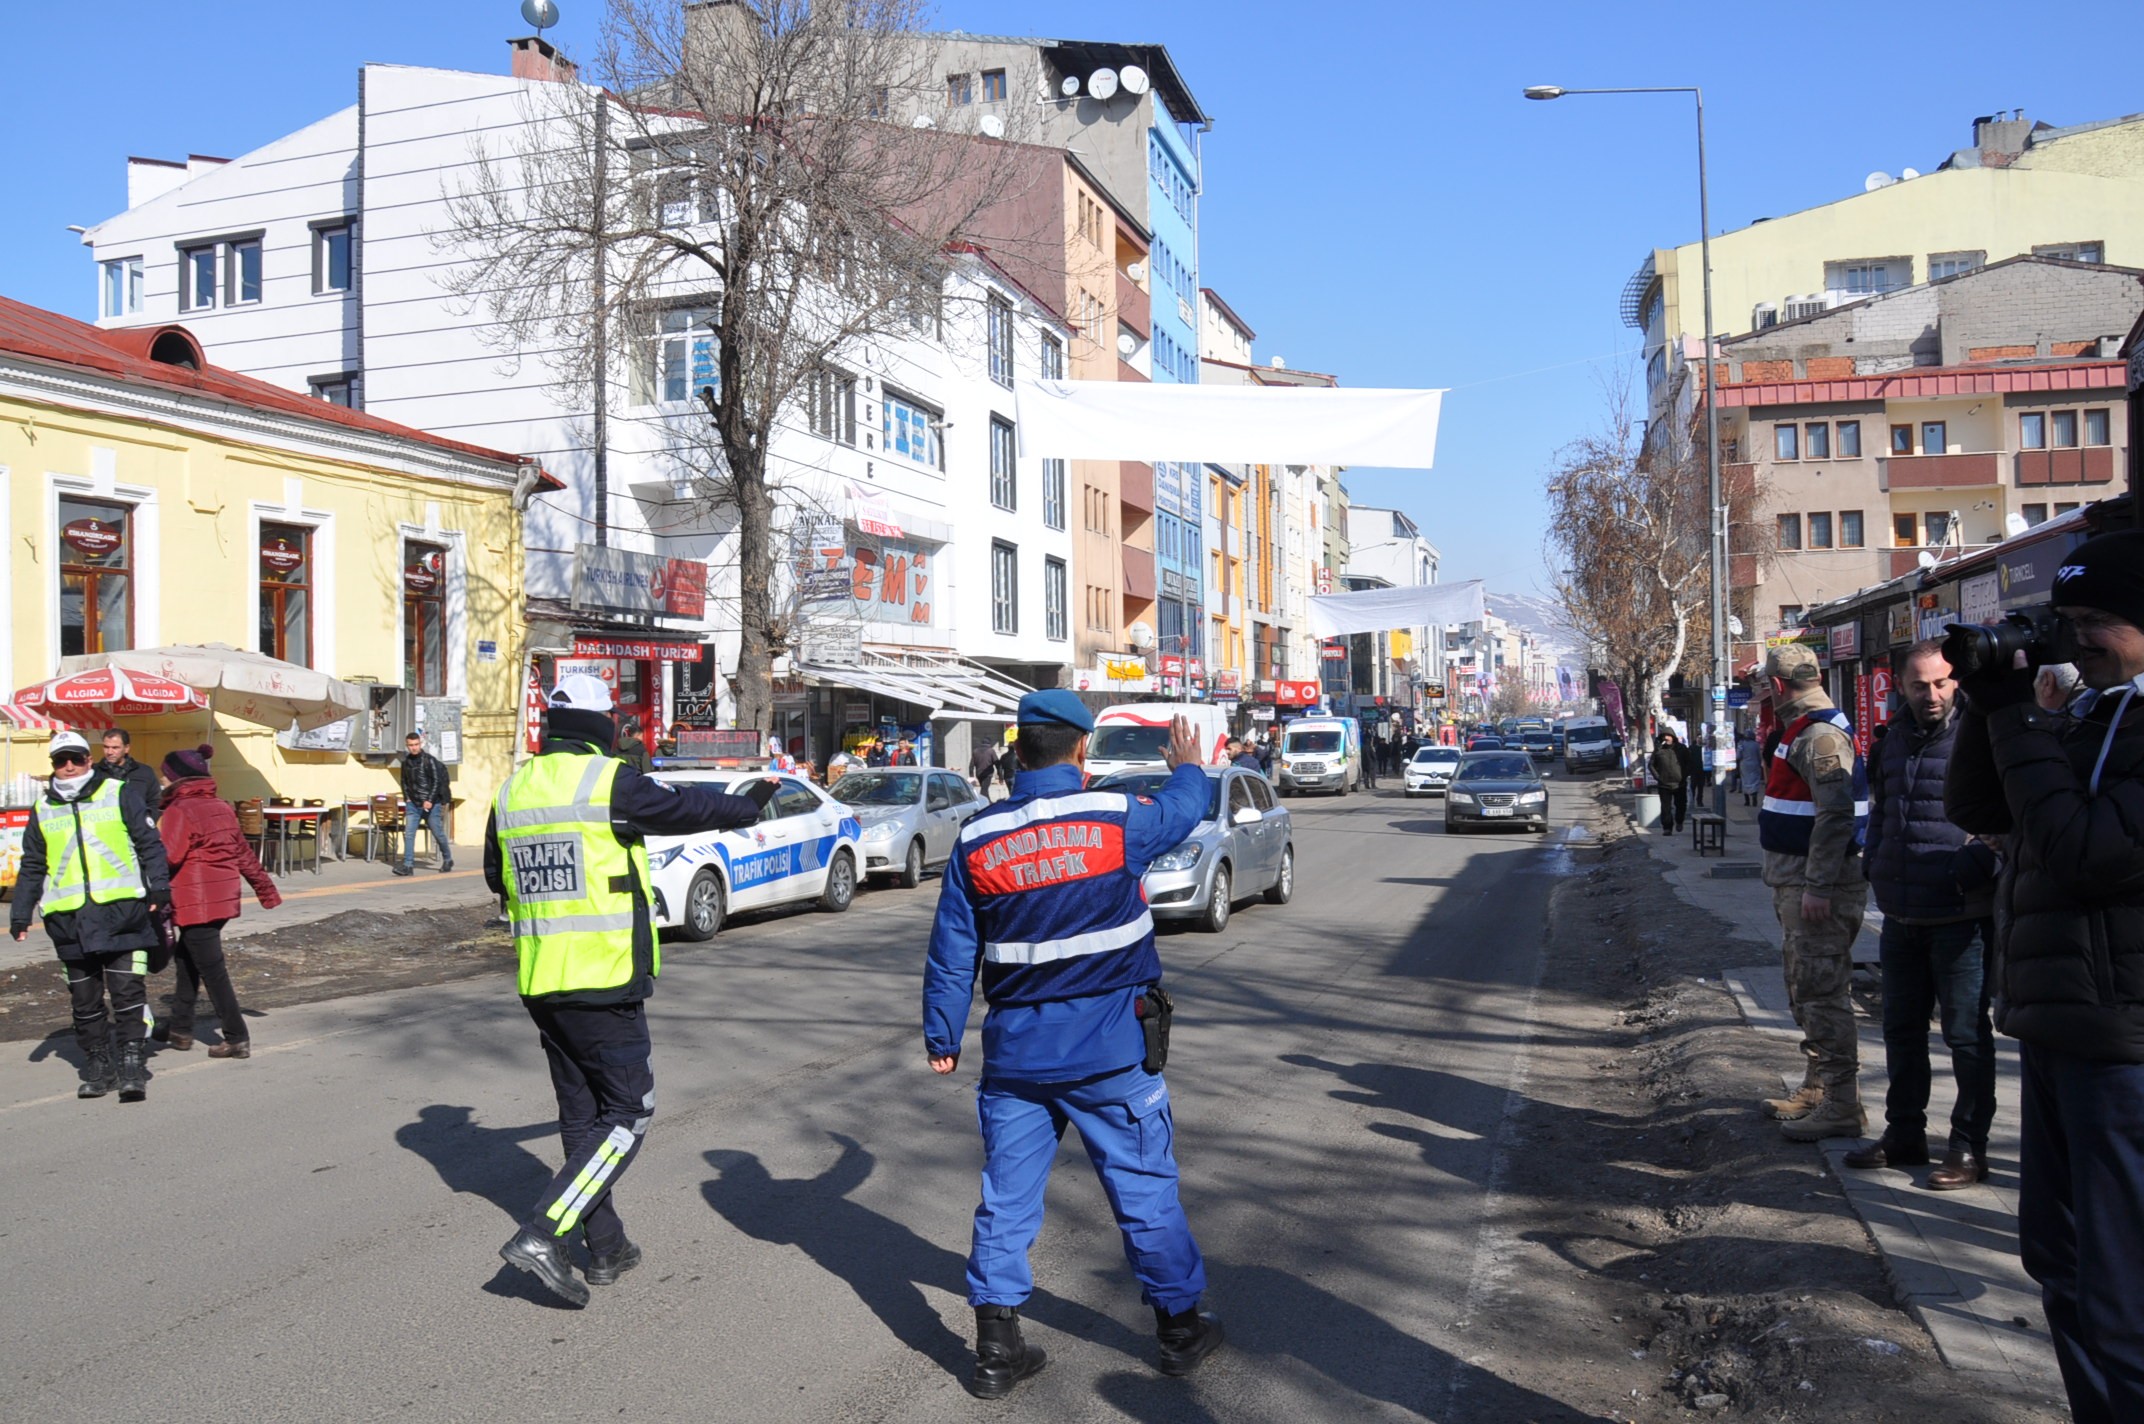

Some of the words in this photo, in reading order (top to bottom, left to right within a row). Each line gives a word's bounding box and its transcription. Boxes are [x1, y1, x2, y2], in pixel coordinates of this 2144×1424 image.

[586, 566, 617, 583] TURKISH
[655, 644, 698, 659] TURİZM
[560, 665, 600, 674] TURKISH
[527, 688, 541, 743] THY
[983, 825, 1103, 871] JANDARMA
[733, 857, 763, 885] TRAFİK
[763, 851, 790, 877] POLİSİ
[1010, 850, 1088, 886] TRAFİK
